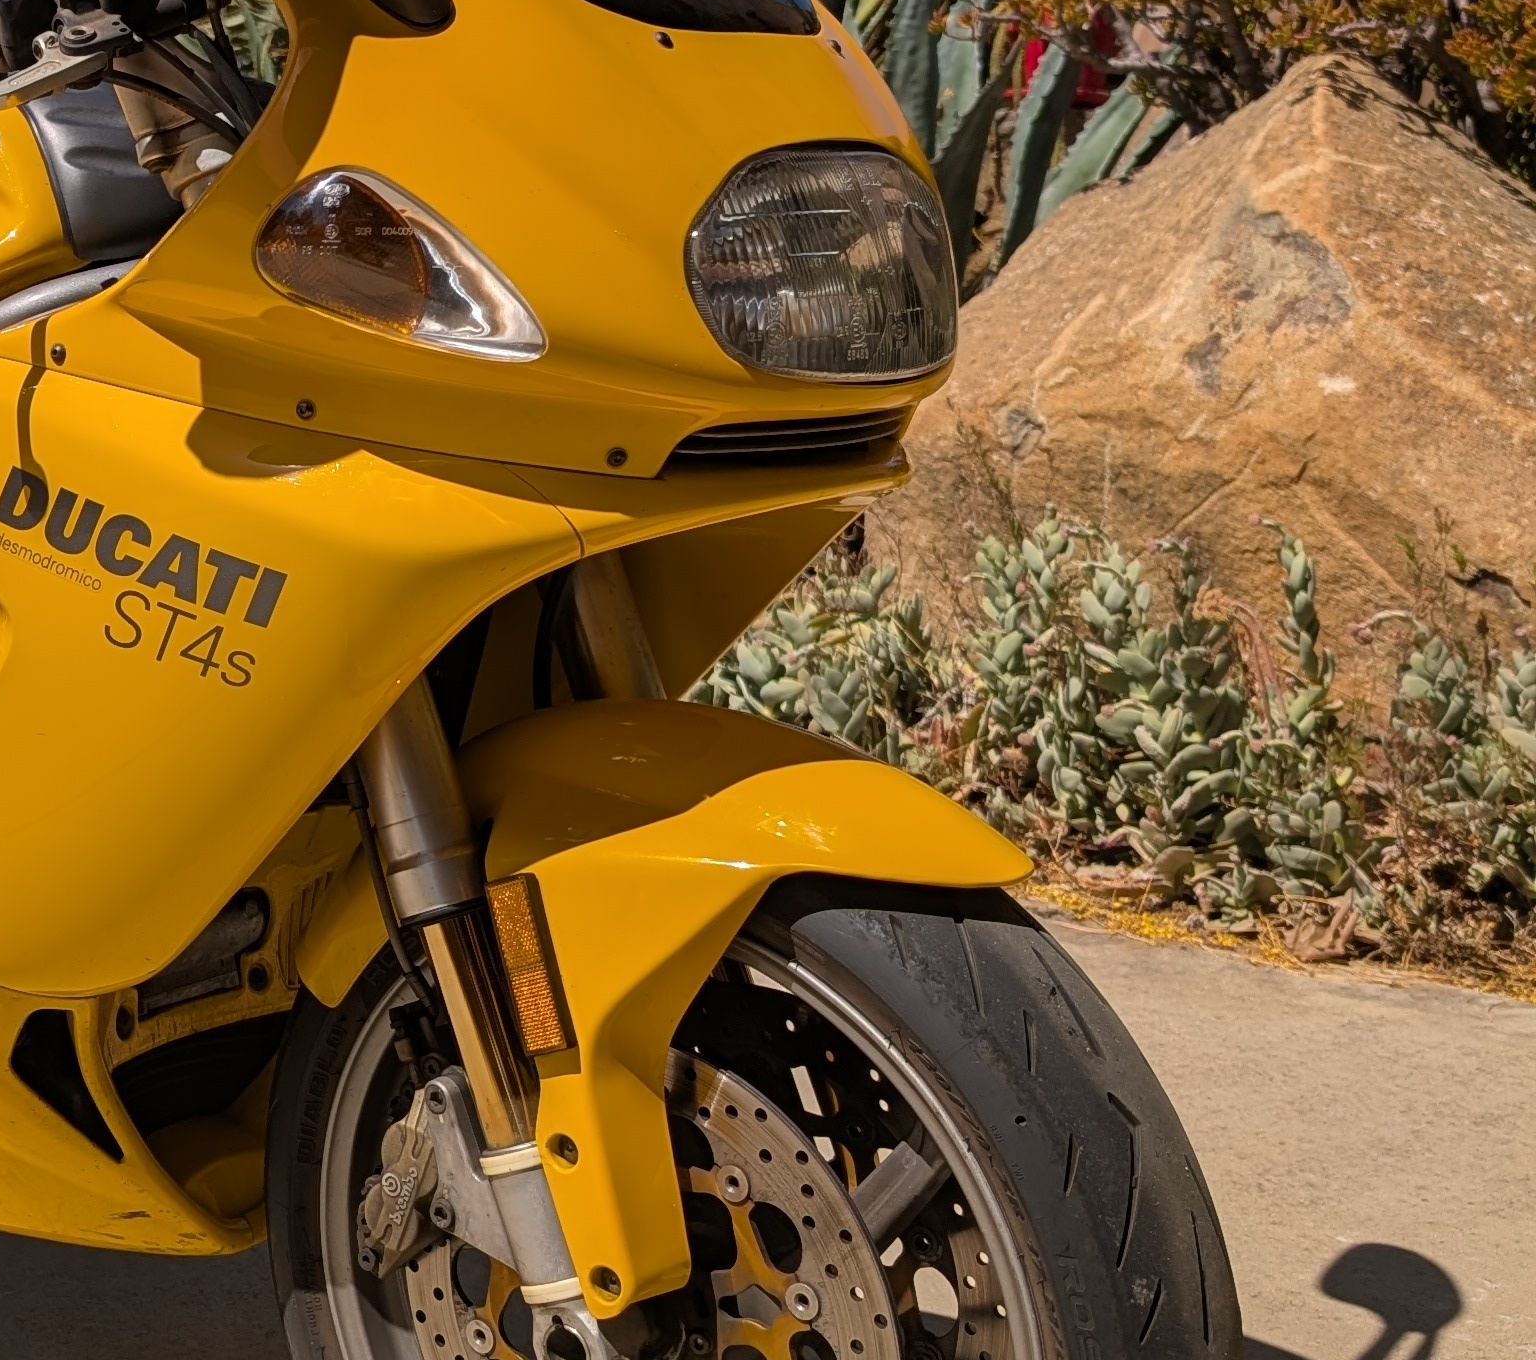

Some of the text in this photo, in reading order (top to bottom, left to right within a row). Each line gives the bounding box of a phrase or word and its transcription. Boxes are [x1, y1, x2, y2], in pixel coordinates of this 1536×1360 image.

[104, 591, 256, 687] ST4s
[297, 1026, 347, 1164] DIABLO
[389, 1167, 418, 1225] brembo
